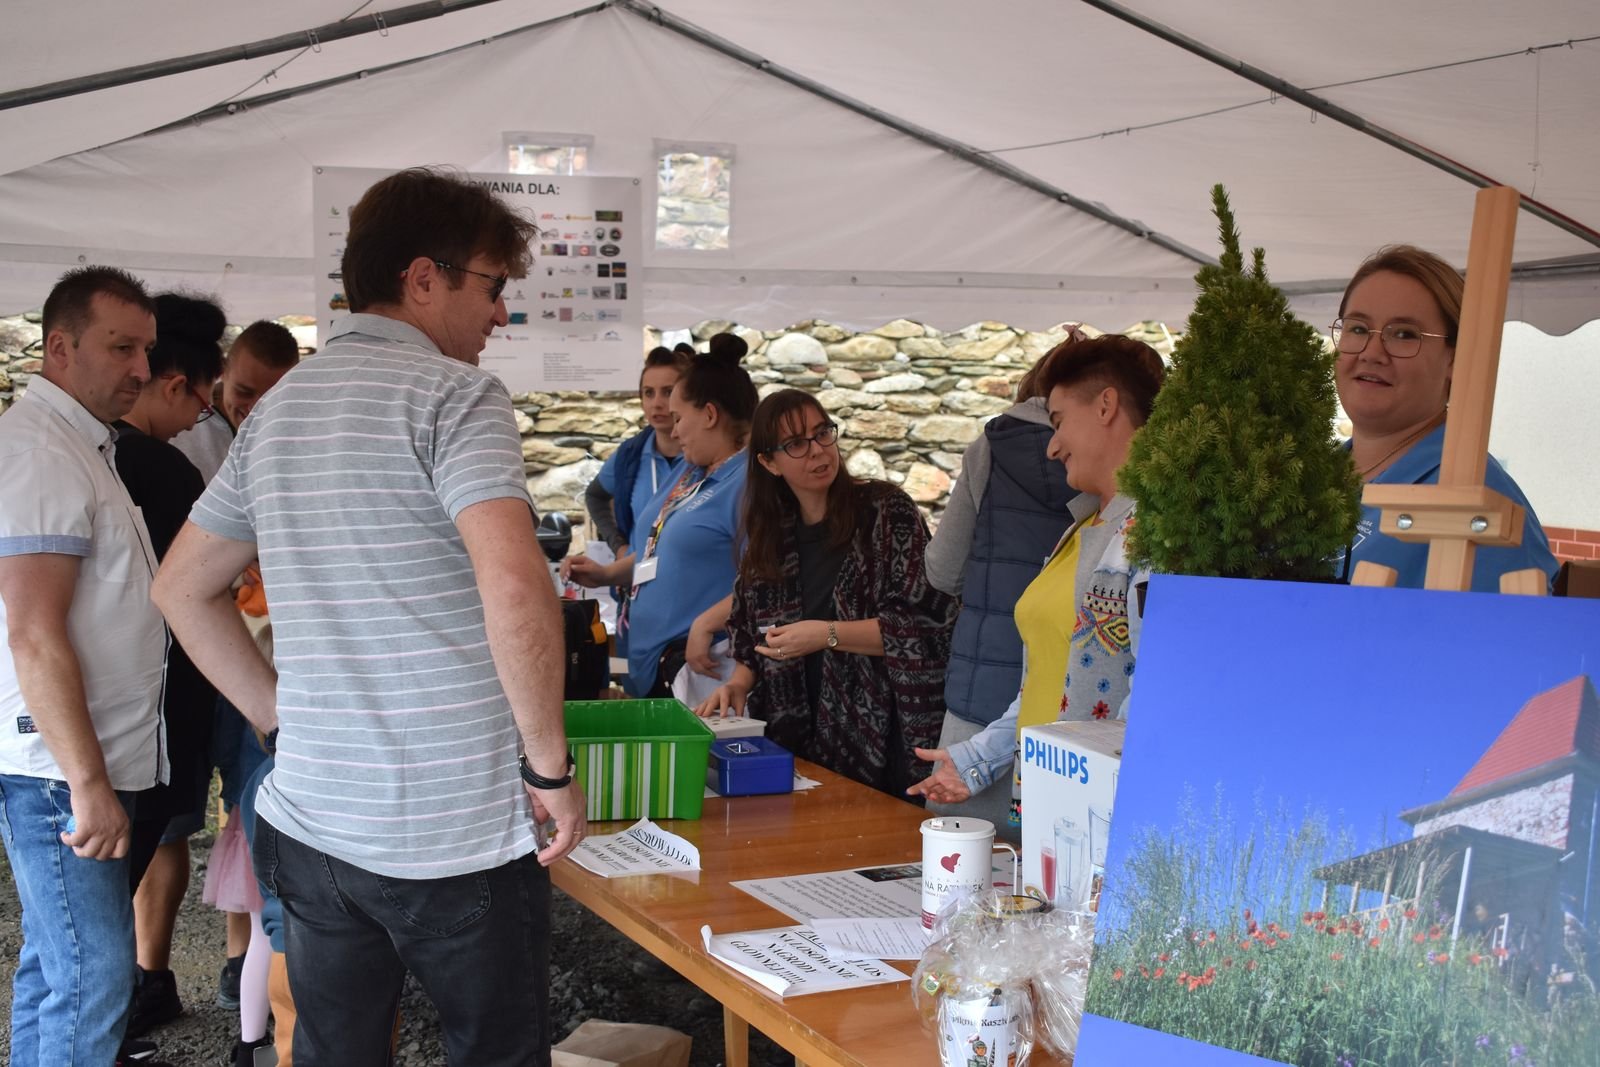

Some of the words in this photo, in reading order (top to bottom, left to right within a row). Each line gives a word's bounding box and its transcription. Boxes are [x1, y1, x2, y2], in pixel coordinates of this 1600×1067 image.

[528, 182, 560, 195] DLA:
[1024, 736, 1089, 785] PHILIPS
[925, 880, 934, 890] NA
[767, 943, 817, 973] NAGRODY
[789, 941, 859, 979] LOSOWANIE
[857, 961, 887, 977] LOS
